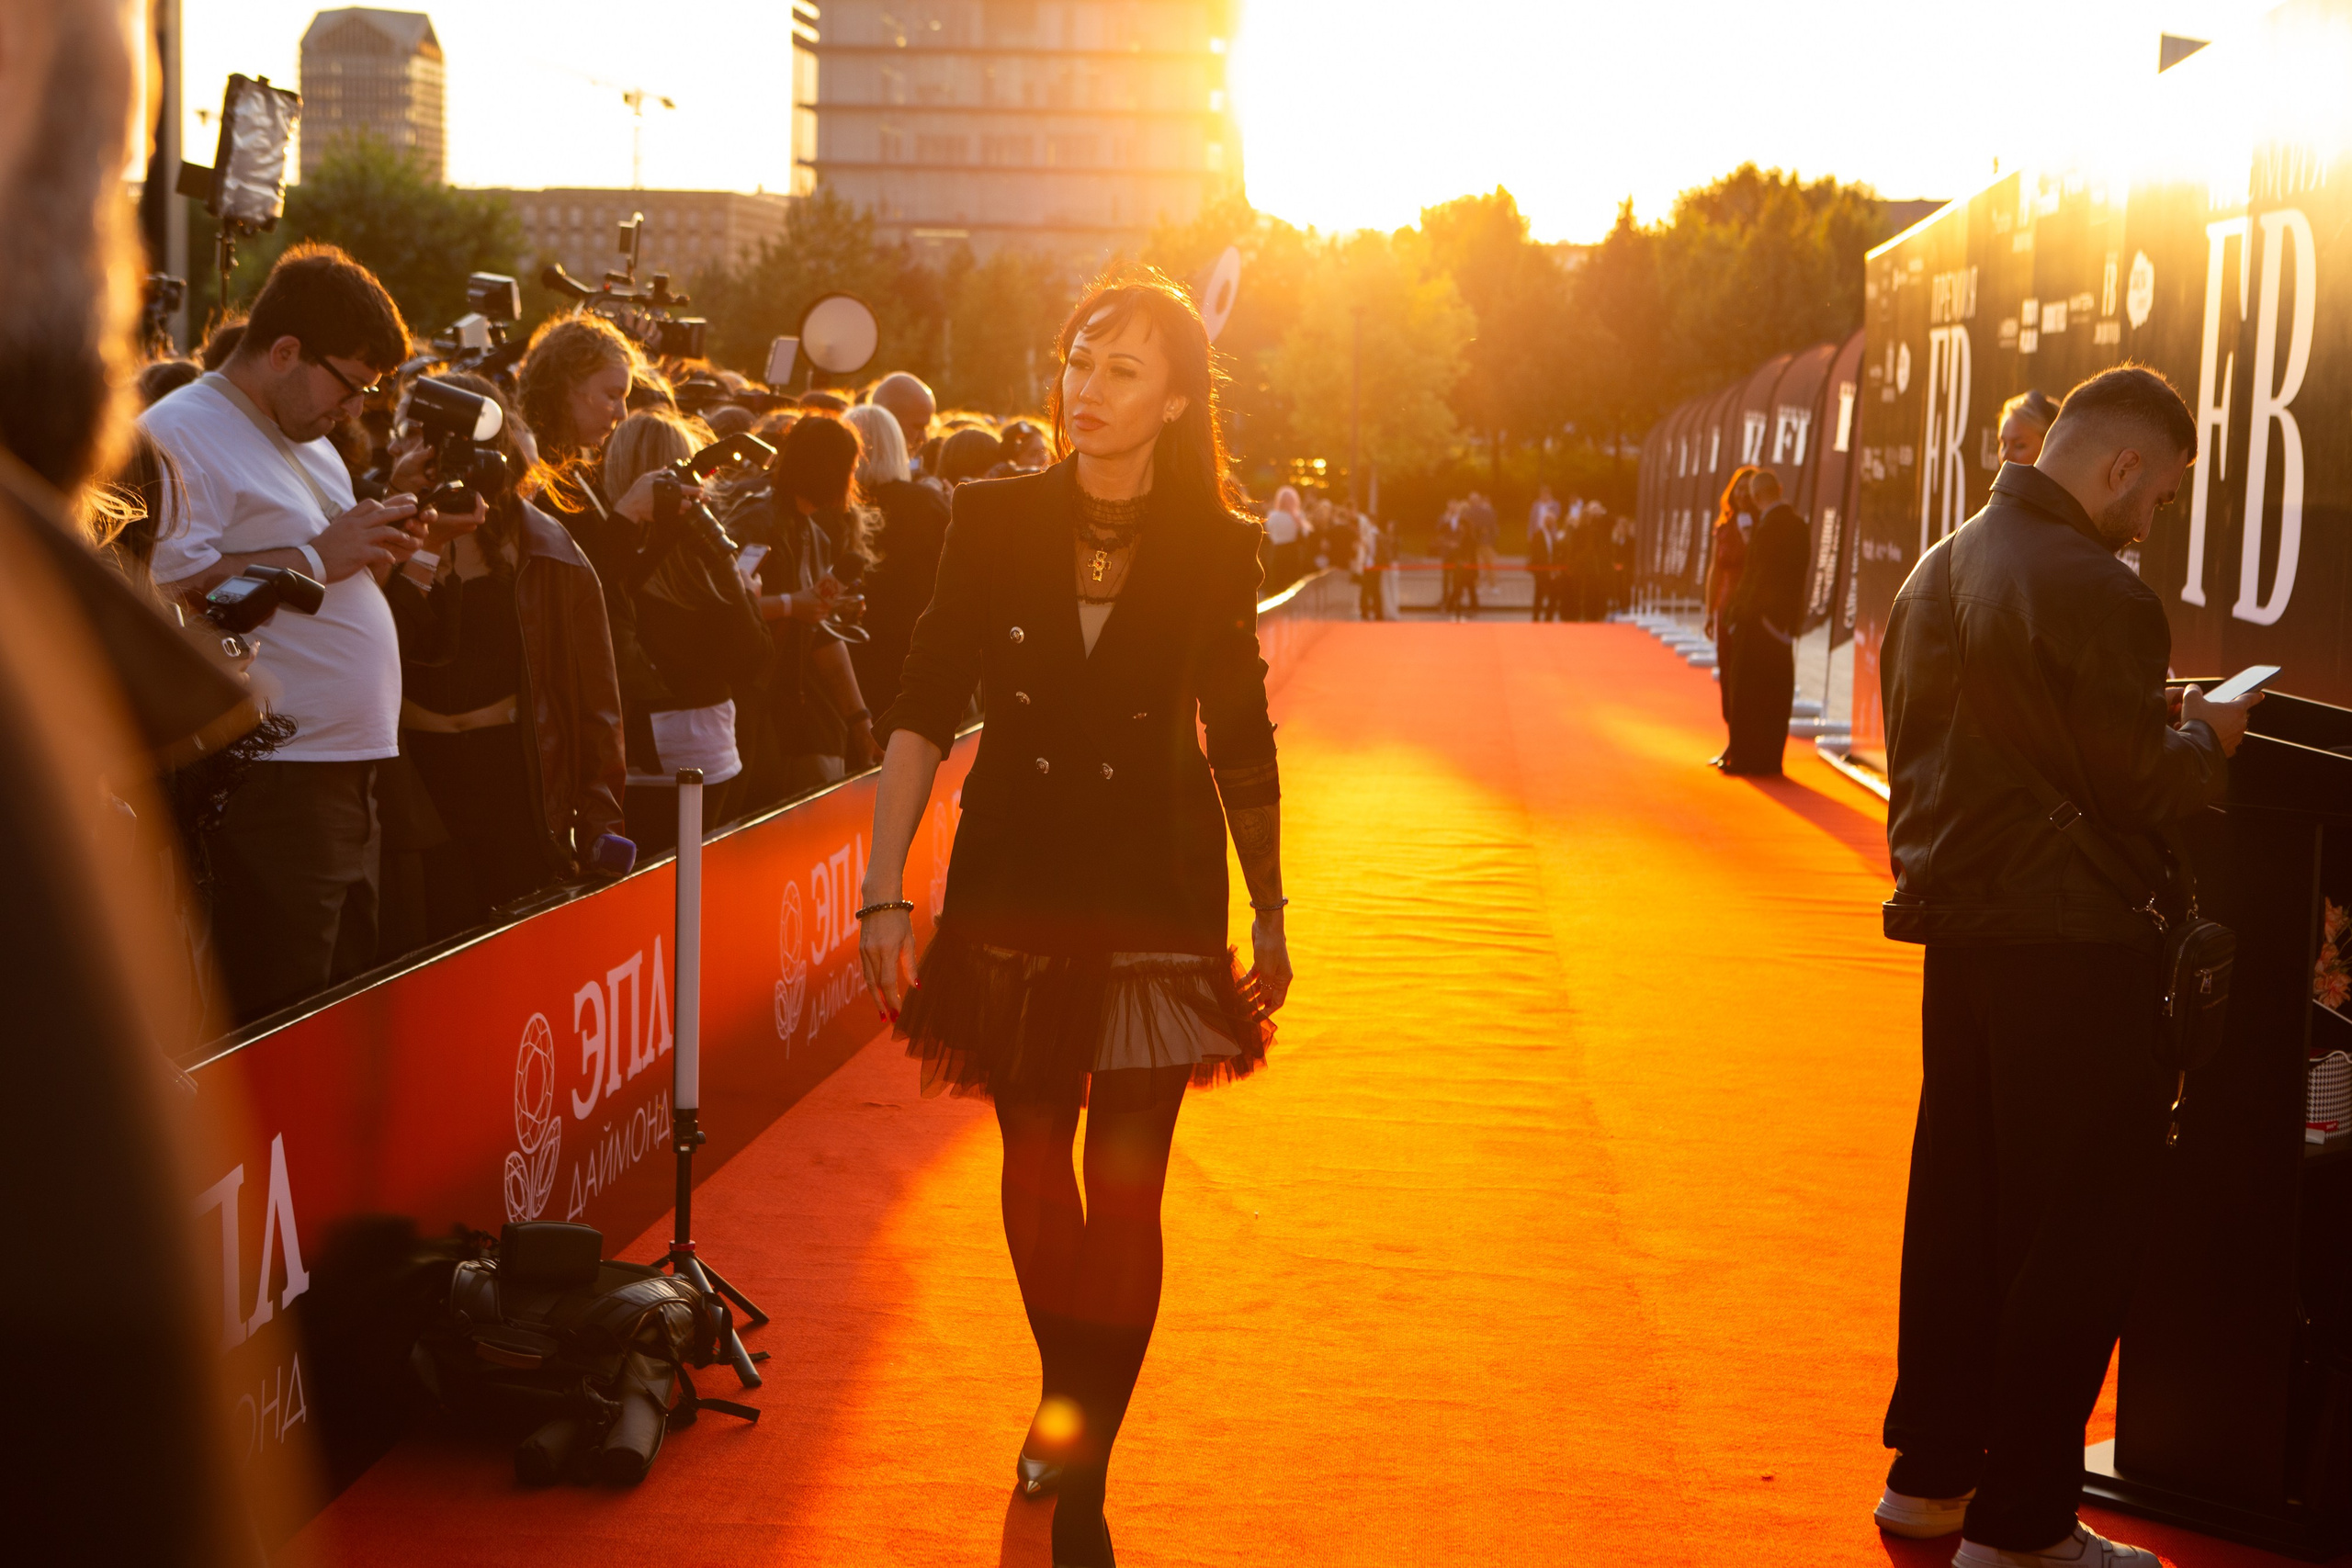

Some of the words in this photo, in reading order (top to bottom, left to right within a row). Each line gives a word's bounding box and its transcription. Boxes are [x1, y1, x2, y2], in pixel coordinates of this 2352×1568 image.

[2180, 208, 2317, 626] FB
[571, 934, 673, 1121] ЭПЛ
[191, 1131, 310, 1356] ПЛ
[567, 1089, 671, 1223] ДАЙМОНД
